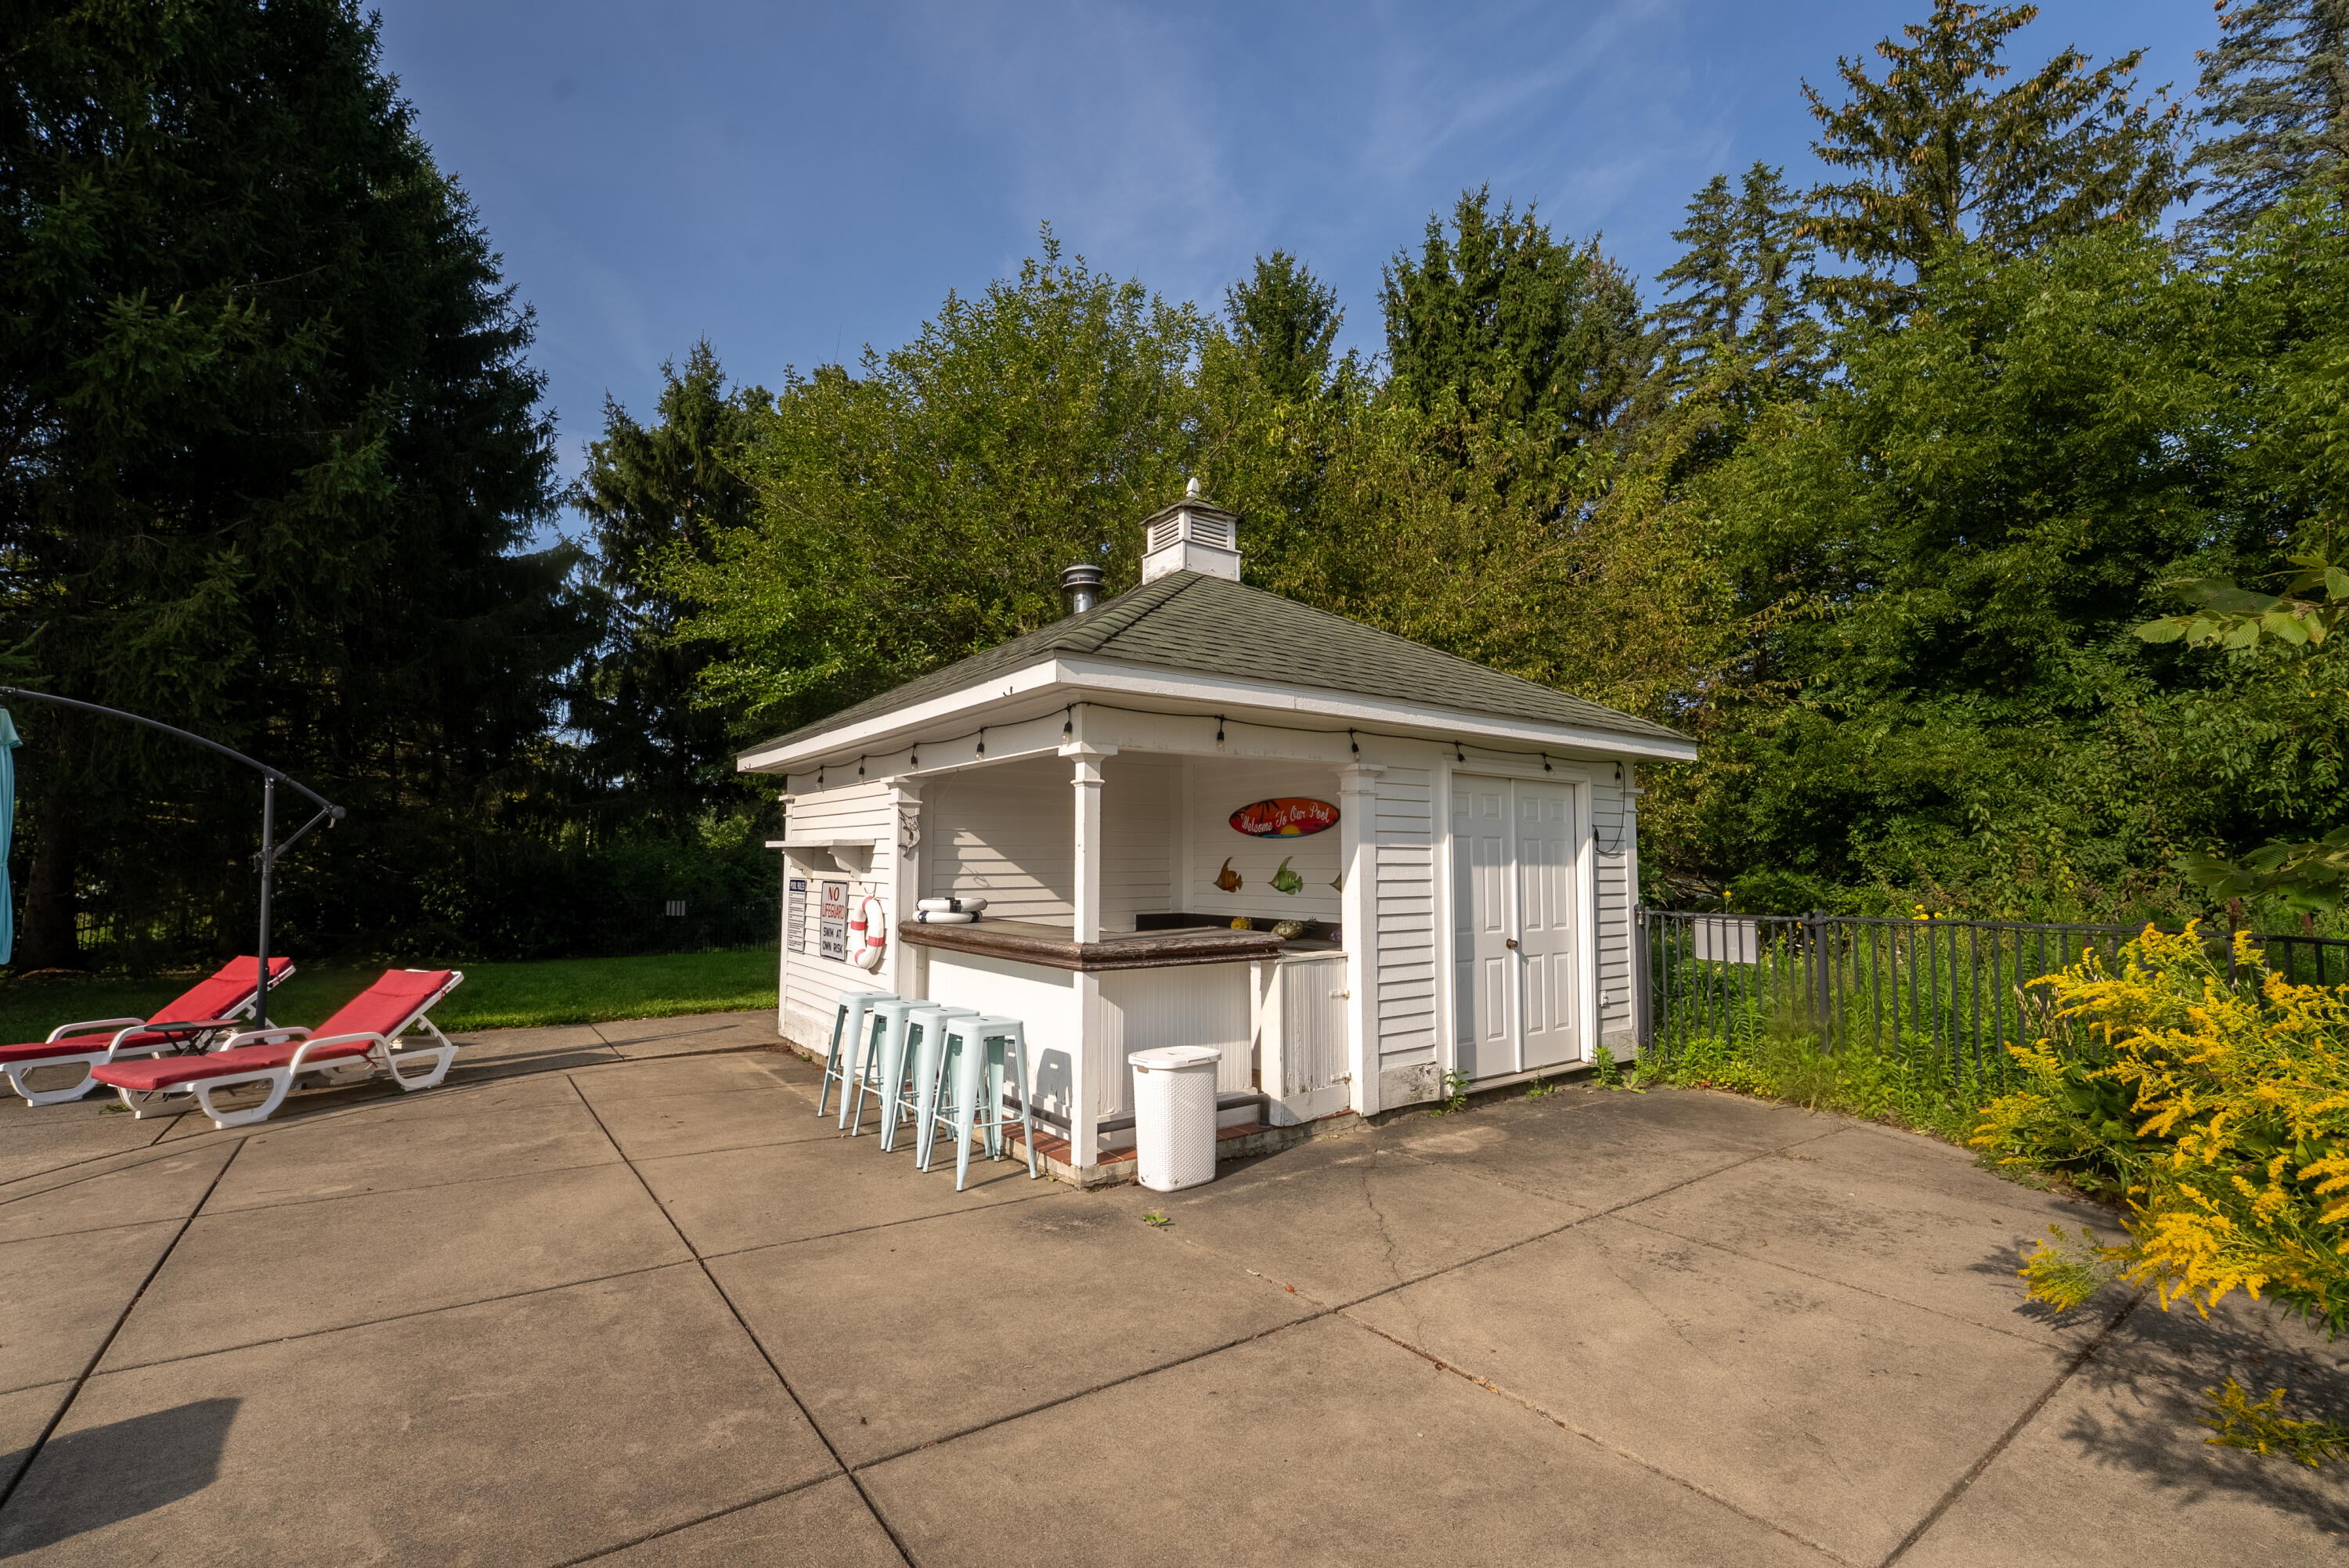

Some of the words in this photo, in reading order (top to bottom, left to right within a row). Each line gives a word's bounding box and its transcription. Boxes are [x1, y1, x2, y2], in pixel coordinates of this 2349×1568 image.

[1240, 813, 1273, 833] Welcome
[1275, 810, 1287, 827] To
[1290, 805, 1306, 821] Our
[1309, 802, 1330, 823] Pool
[828, 886, 839, 901] NO
[822, 903, 845, 920] LIFEGUARD
[823, 927, 834, 938] SWIM
[836, 929, 842, 939] AT
[822, 940, 832, 951] OWN
[833, 943, 843, 954] RISK
